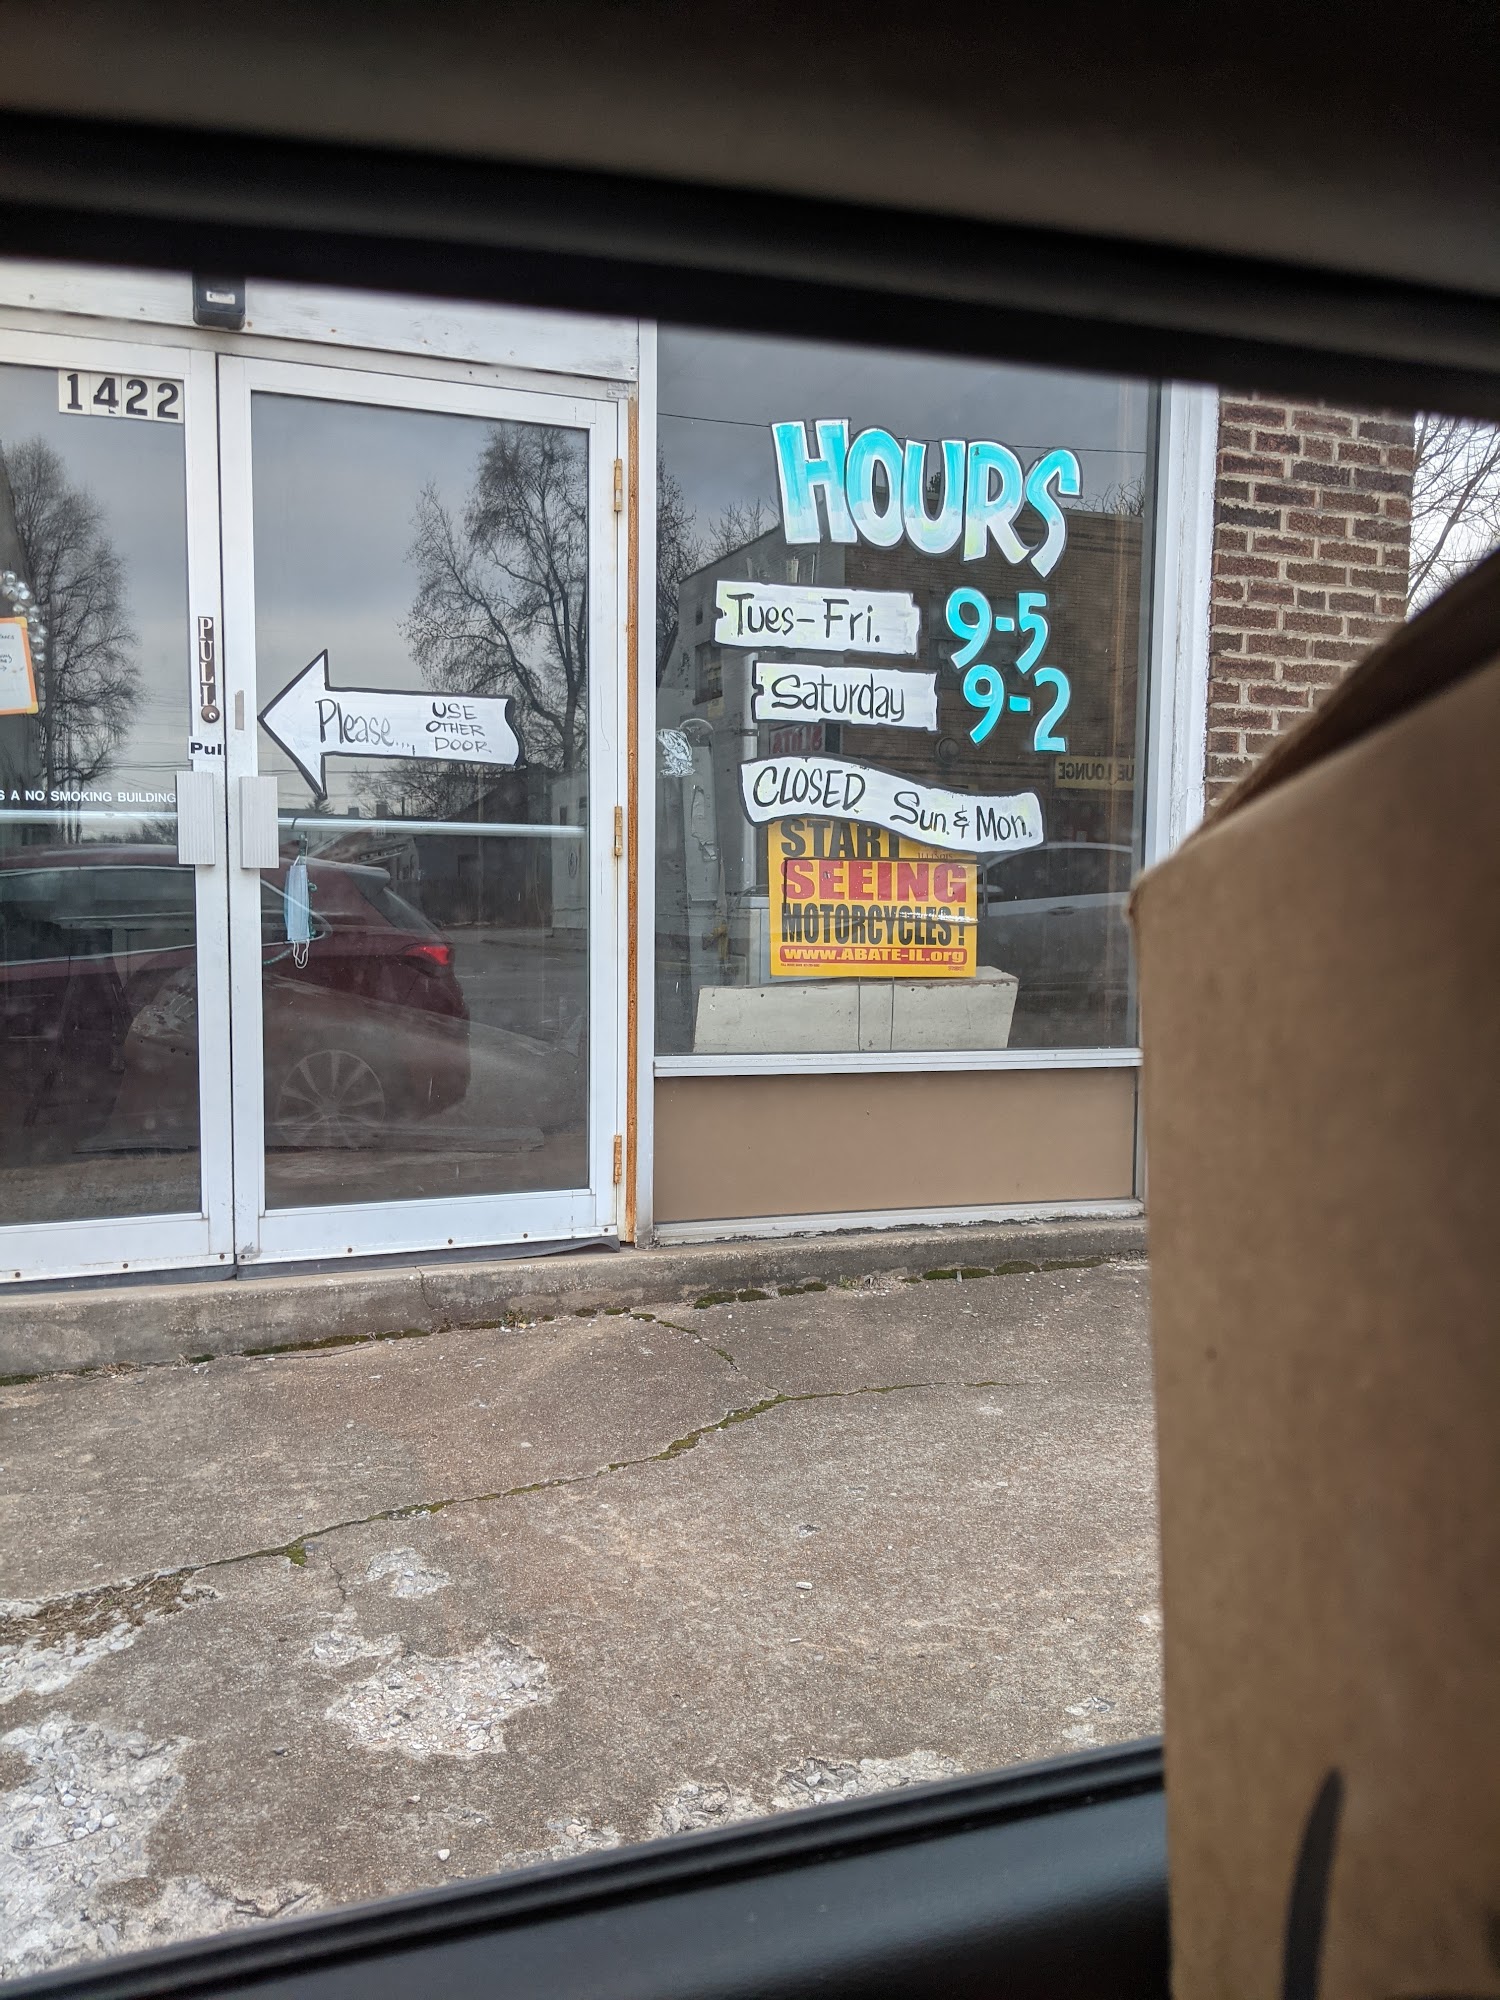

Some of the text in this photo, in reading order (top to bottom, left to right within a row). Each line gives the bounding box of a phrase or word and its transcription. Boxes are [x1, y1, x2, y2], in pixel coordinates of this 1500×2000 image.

[67, 373, 179, 420] 1422
[771, 418, 1082, 580] HOURS
[945, 586, 1050, 674] 9-5
[198, 616, 215, 707] PULL
[425, 720, 486, 737] OTHER
[431, 701, 478, 720] USE
[770, 664, 1071, 753] Saturday 9-2
[434, 736, 491, 753] DOOR
[11, 790, 20, 801] A
[25, 790, 46, 802] NO
[50, 790, 113, 803] SMOKING
[117, 792, 177, 804] BUILDING
[752, 765, 1033, 842] CLOSED Sun. & Mon.
[780, 859, 968, 904] SEEING
[784, 947, 965, 964] www.ABATE-IL.org
